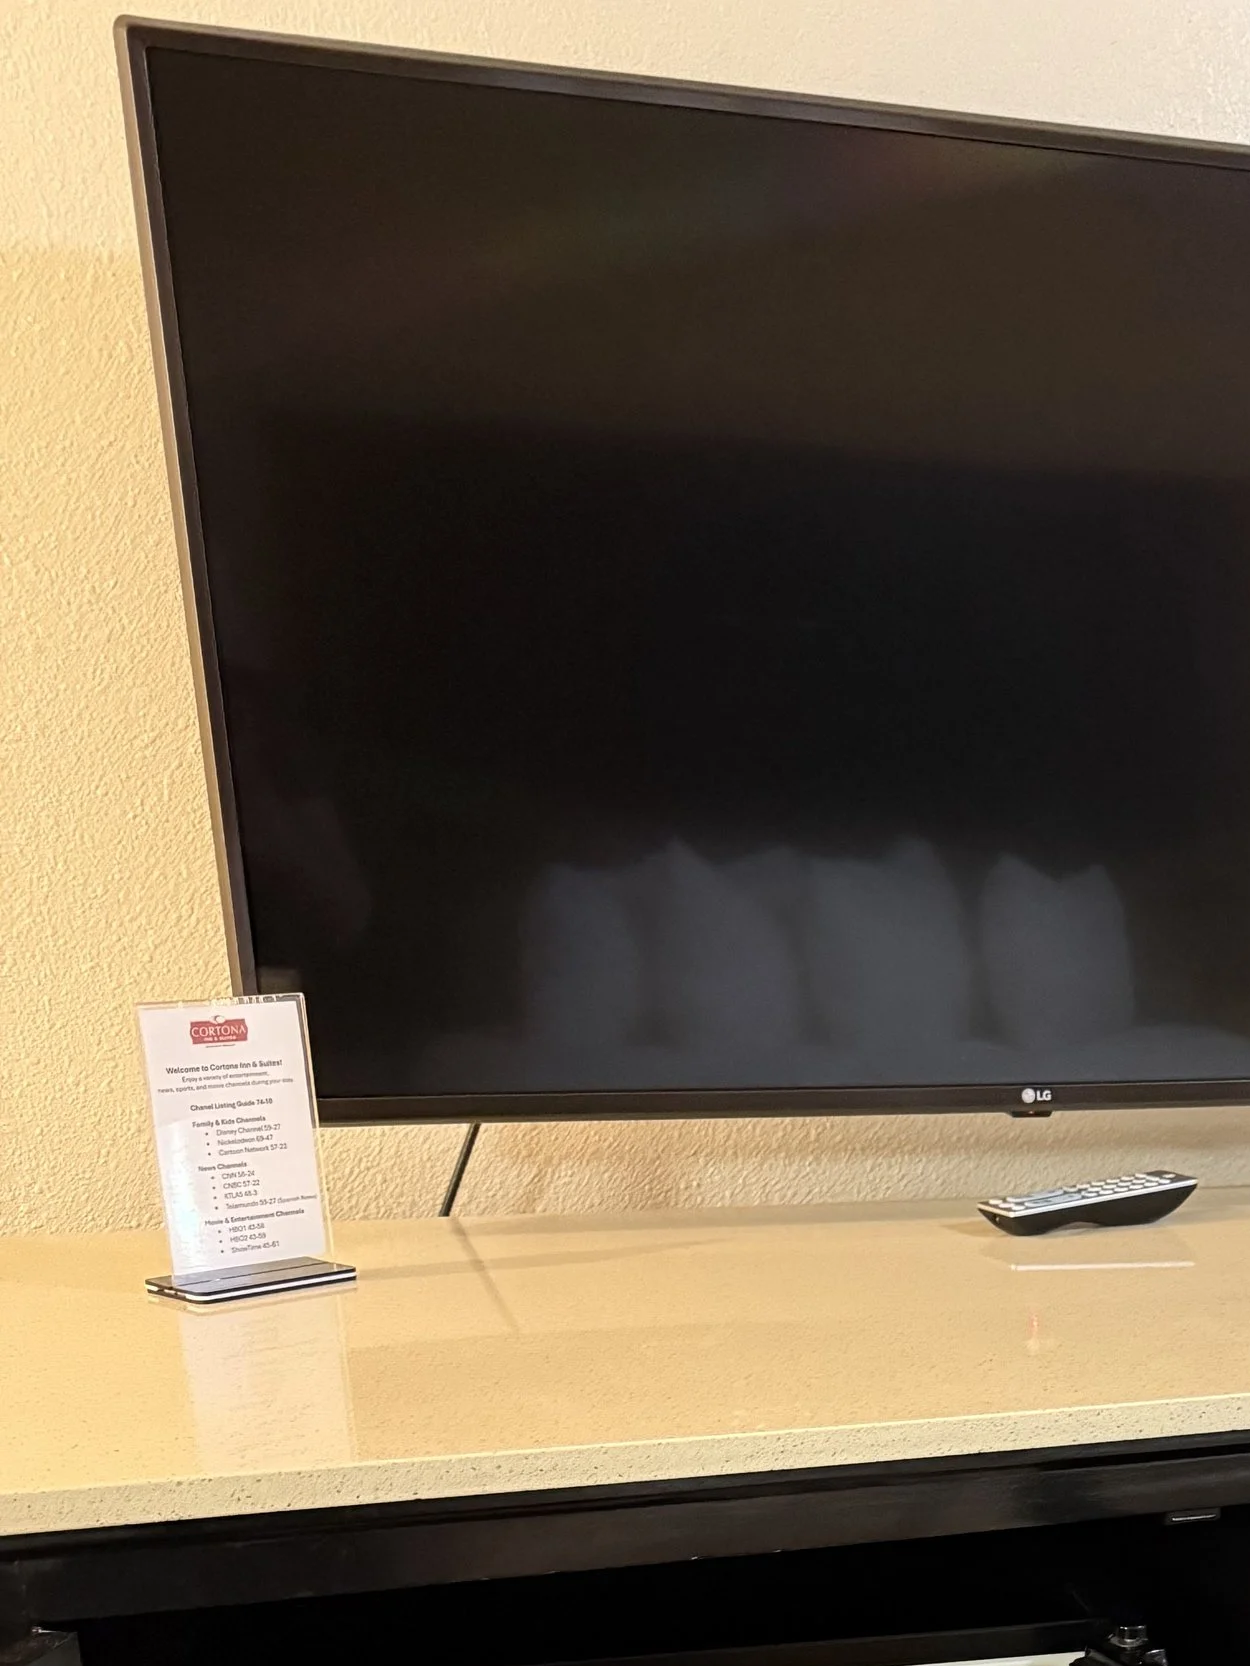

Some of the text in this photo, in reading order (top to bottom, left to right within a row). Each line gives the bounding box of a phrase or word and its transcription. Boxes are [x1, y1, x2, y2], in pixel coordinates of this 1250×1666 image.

[192, 1025, 246, 1037] CORTONA
[1036, 1090, 1052, 1101] LG
[238, 1125, 263, 1133] Channel
